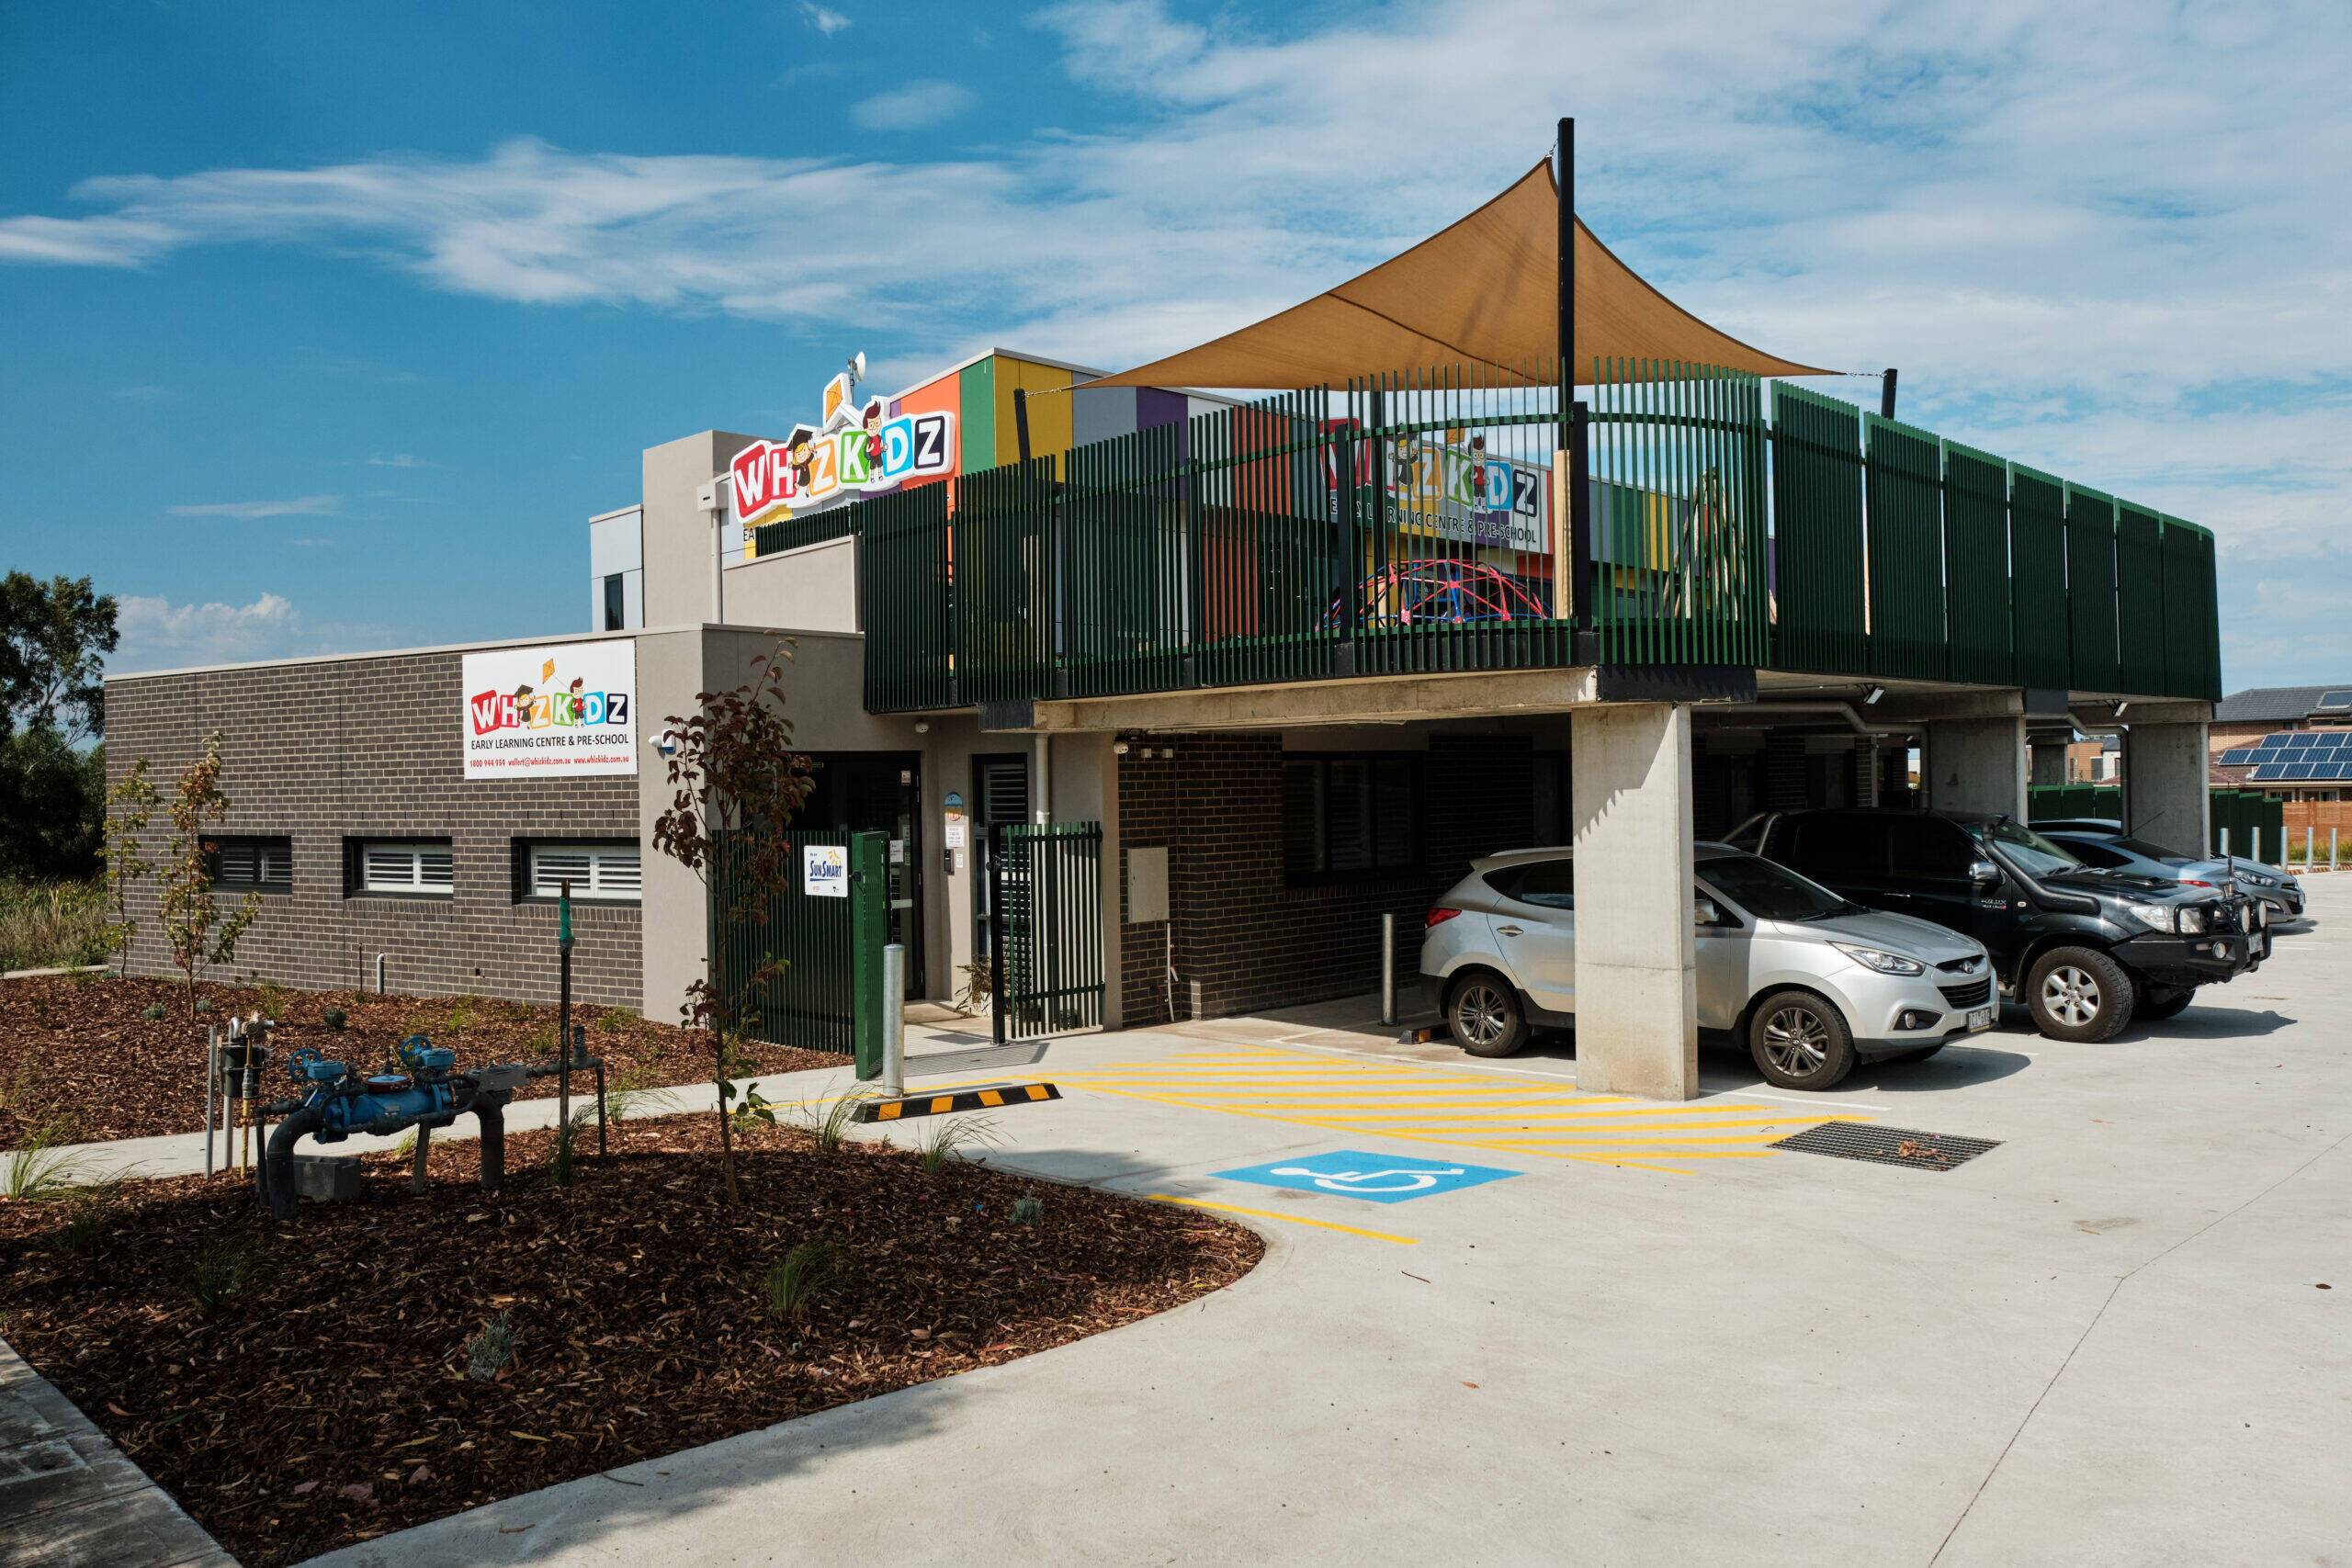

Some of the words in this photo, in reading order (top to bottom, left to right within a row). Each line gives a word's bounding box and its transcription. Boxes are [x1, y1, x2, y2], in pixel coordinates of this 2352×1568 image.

[734, 415, 944, 518] WHZKDZ
[1477, 521, 1536, 543] PRE-SCHOOL
[471, 690, 628, 735] WHZKDZ
[471, 739, 493, 750] EARLY
[495, 738, 534, 749] LEARNING
[536, 736, 566, 747] CENTRE
[568, 735, 575, 746] &
[577, 734, 629, 745] PRE-SCHOOL
[469, 760, 483, 768] 1800
[484, 759, 494, 767] 944
[573, 754, 629, 764] www.whizkidz.com.au
